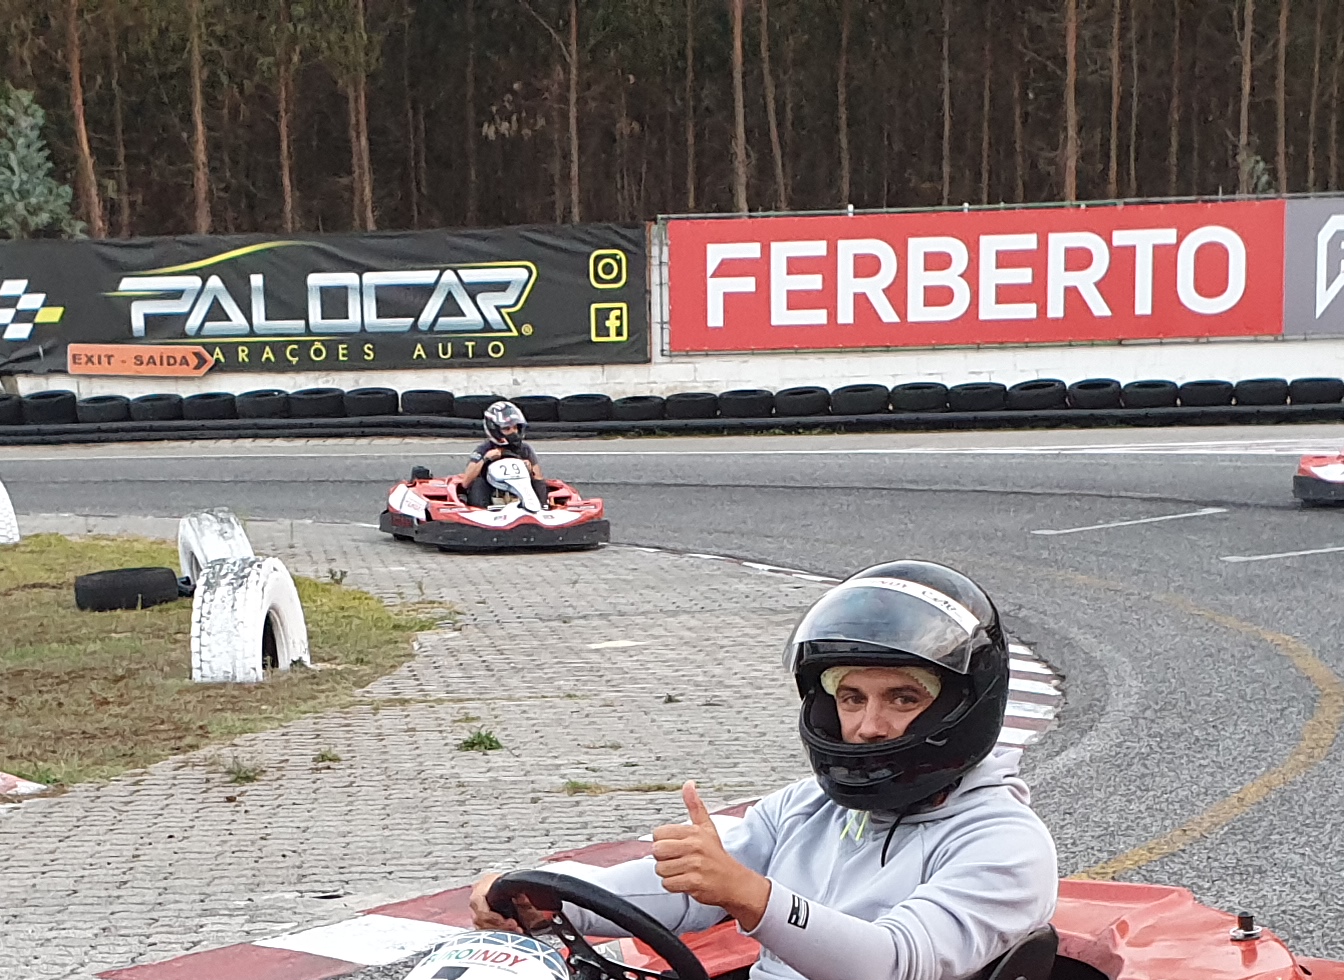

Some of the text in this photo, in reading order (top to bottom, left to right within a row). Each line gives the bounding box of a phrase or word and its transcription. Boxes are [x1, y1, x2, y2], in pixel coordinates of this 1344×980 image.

[706, 225, 1246, 327] FERBERTO
[117, 267, 537, 340] PALOCAR
[72, 353, 114, 366] EXIT
[134, 352, 190, 366] SAÍDA
[212, 340, 505, 362] ARAÇÕES AUTO
[499, 463, 522, 477] 29
